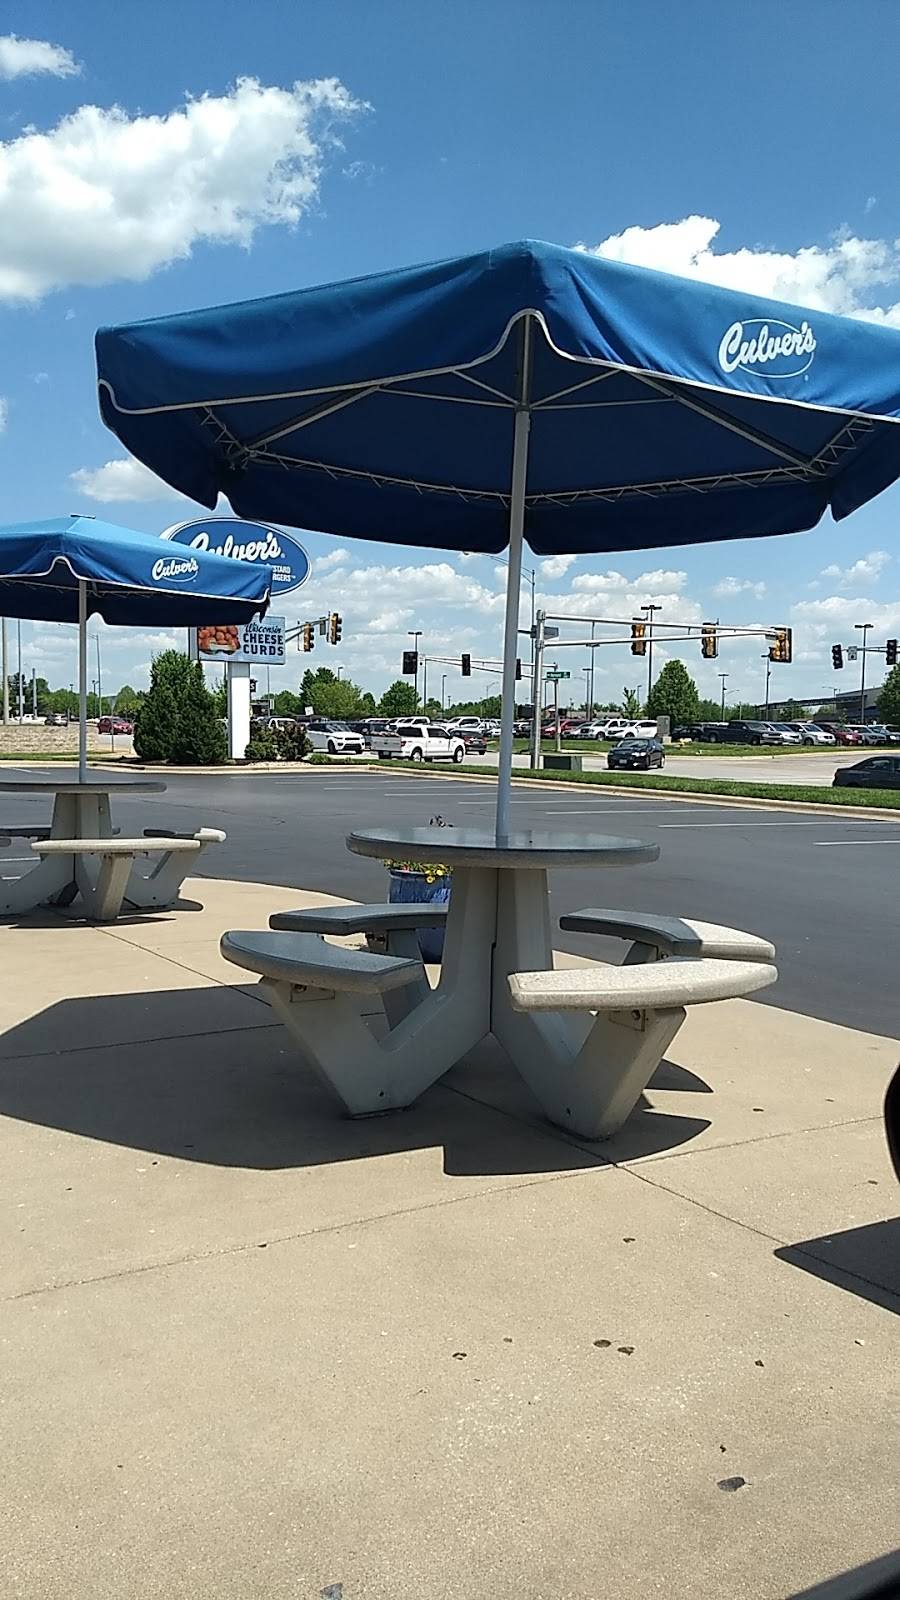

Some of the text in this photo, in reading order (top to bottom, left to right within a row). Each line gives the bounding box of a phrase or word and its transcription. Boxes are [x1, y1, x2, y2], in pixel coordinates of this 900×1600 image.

[718, 321, 817, 373] Culver's
[152, 557, 199, 581] Culver's
[272, 565, 291, 573] STARD
[272, 573, 292, 583] RGERS
[245, 622, 282, 634] Wisconsin
[243, 633, 284, 645] CHEESE
[243, 644, 284, 656] CURDS
